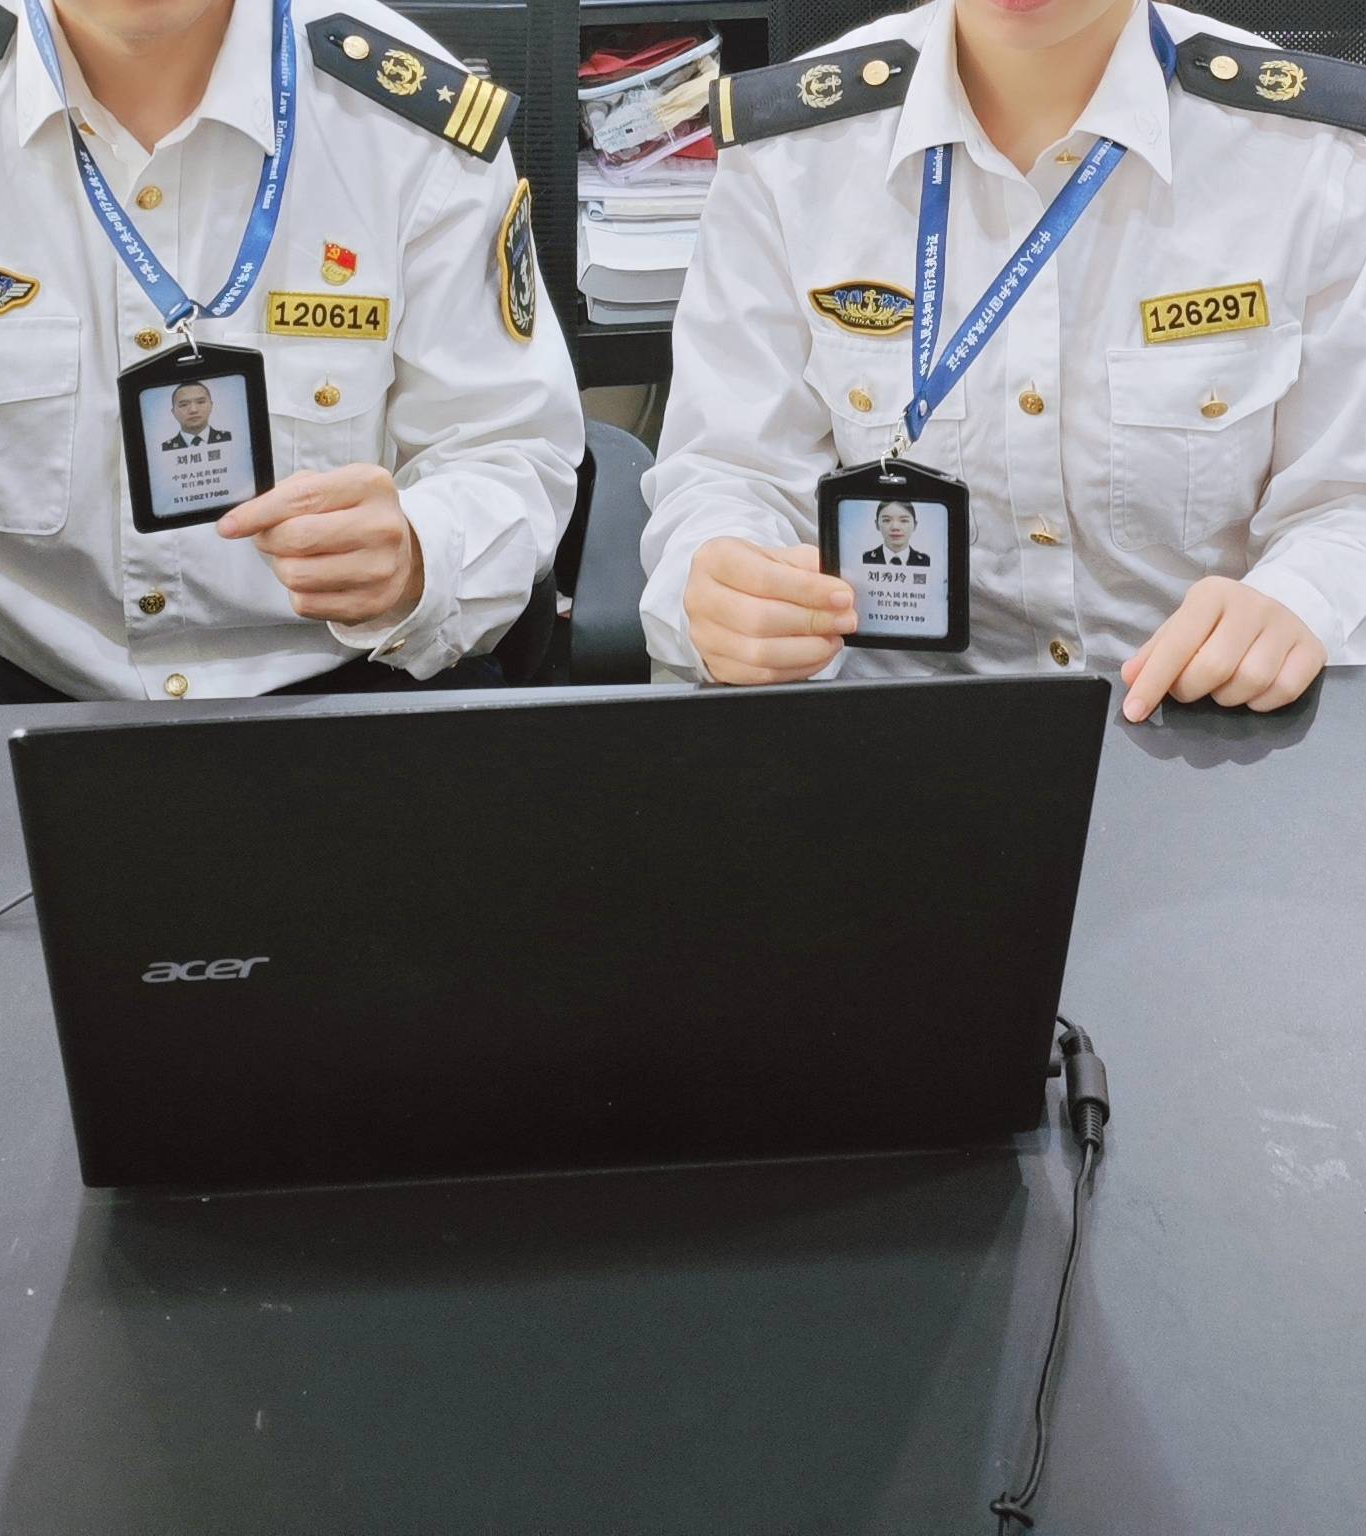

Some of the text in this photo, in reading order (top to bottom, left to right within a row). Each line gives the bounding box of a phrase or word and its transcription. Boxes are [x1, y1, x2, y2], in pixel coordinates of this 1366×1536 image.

[279, 91, 291, 115] Law
[274, 301, 380, 331] 120614
[919, 233, 940, 377] 中华人民共和国行政执法证
[945, 229, 1052, 373] 中华人民共和国行政执法证
[1149, 291, 1257, 333] 126297
[141, 956, 271, 984] acer
